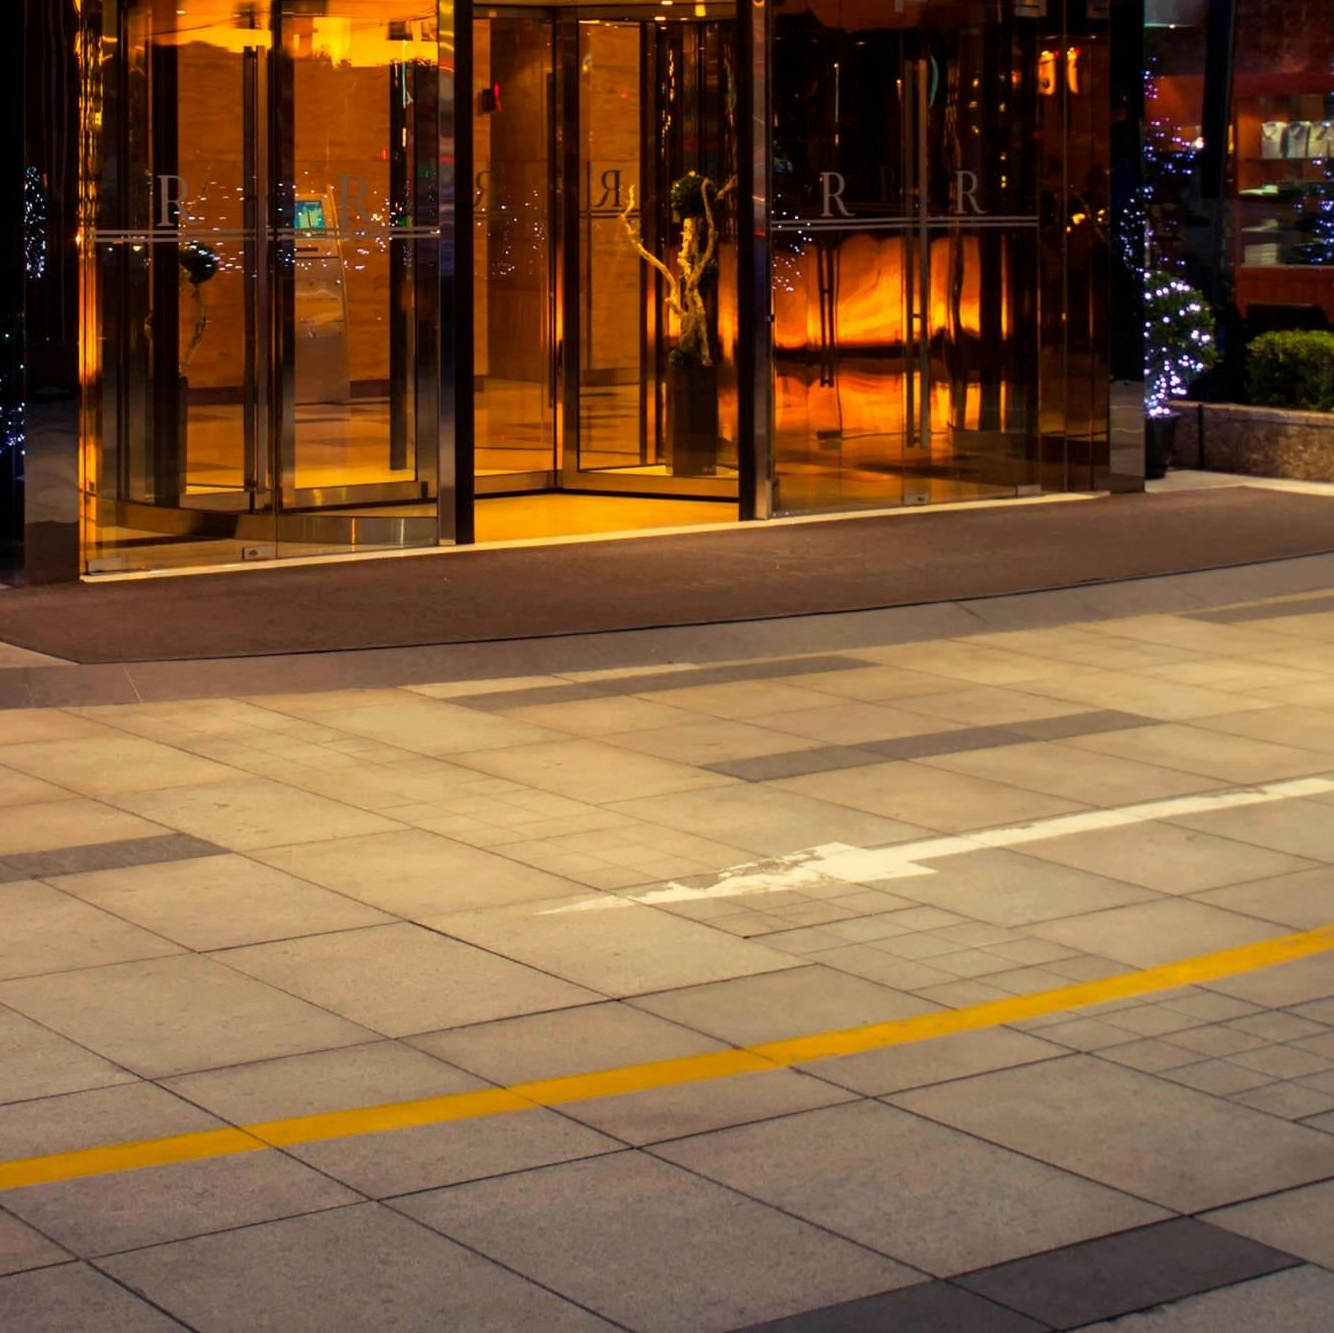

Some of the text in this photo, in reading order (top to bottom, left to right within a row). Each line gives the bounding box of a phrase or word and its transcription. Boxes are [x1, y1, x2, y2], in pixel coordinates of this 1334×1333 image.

[156, 174, 195, 228] R
[819, 171, 857, 217] R
[954, 170, 989, 215] R
